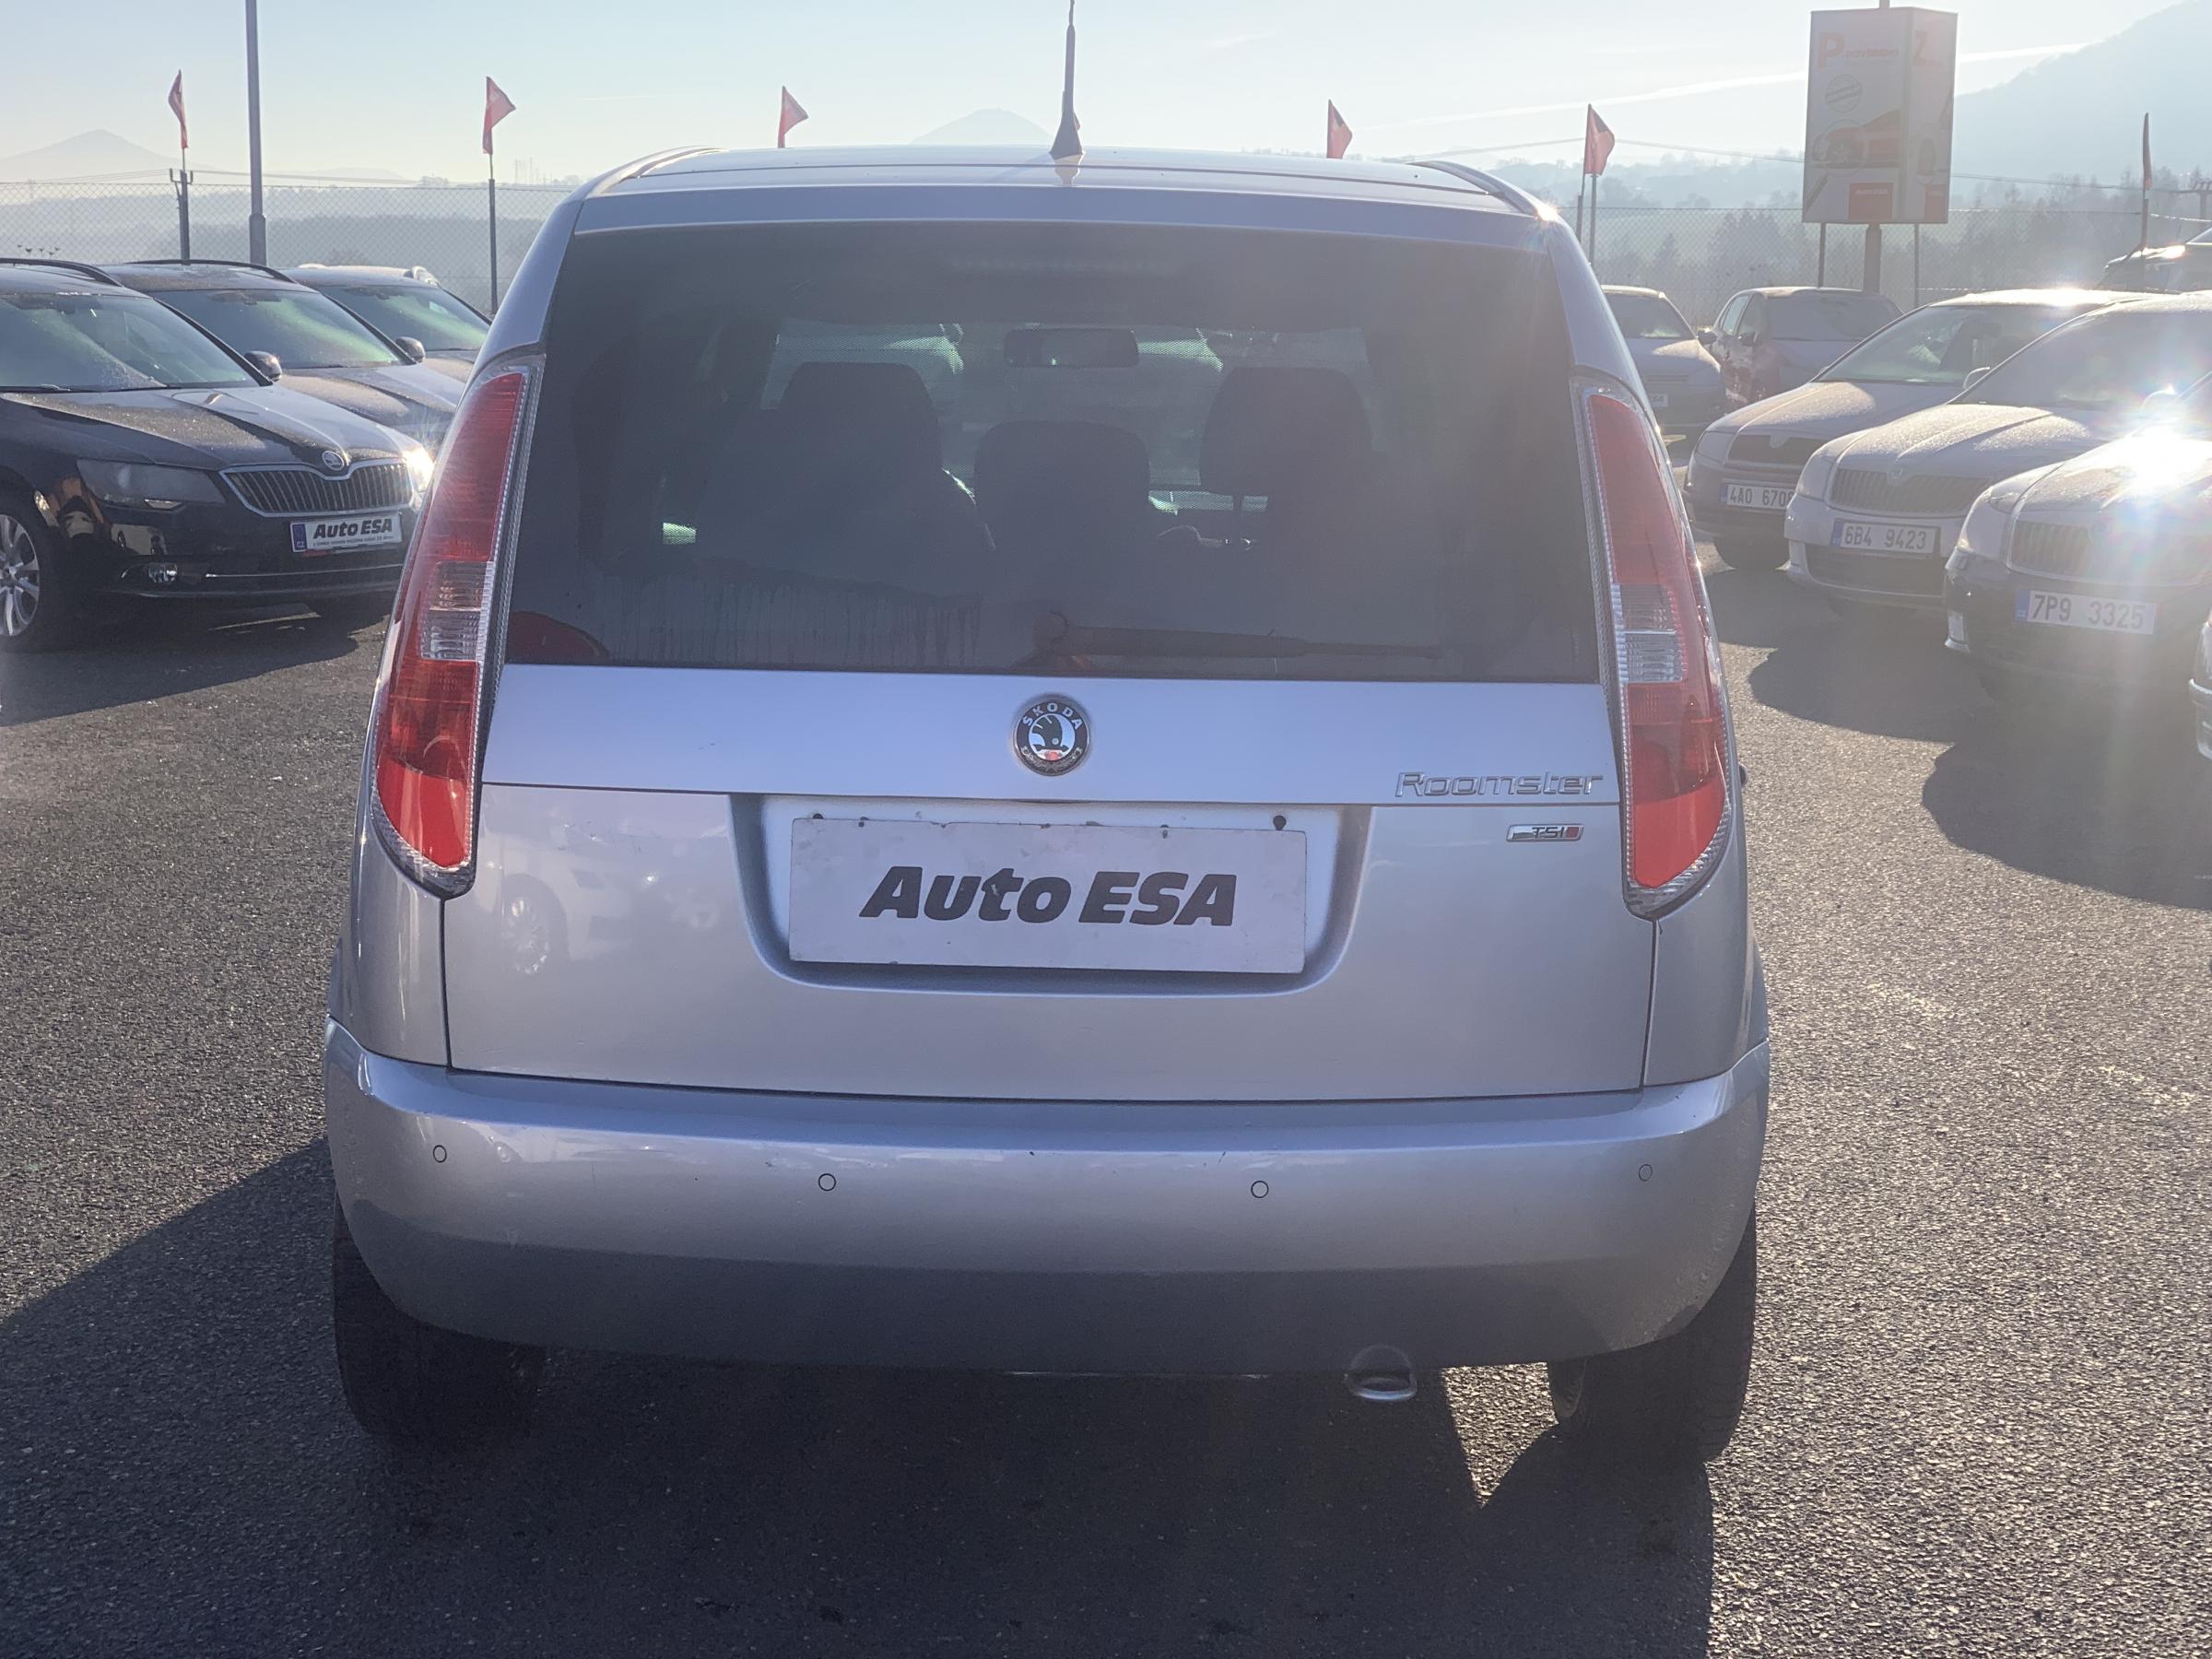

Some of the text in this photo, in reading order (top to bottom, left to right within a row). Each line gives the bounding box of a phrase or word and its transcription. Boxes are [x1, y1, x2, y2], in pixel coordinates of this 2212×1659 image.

[313, 519, 393, 539] Auto ESA
[1844, 525, 1926, 550] 6B4 9423
[2032, 594, 2147, 629] 7P9 3325
[1395, 771, 1604, 797] Roomster
[1532, 826, 1567, 839] TSI
[859, 865, 1238, 927] Auto ESA
